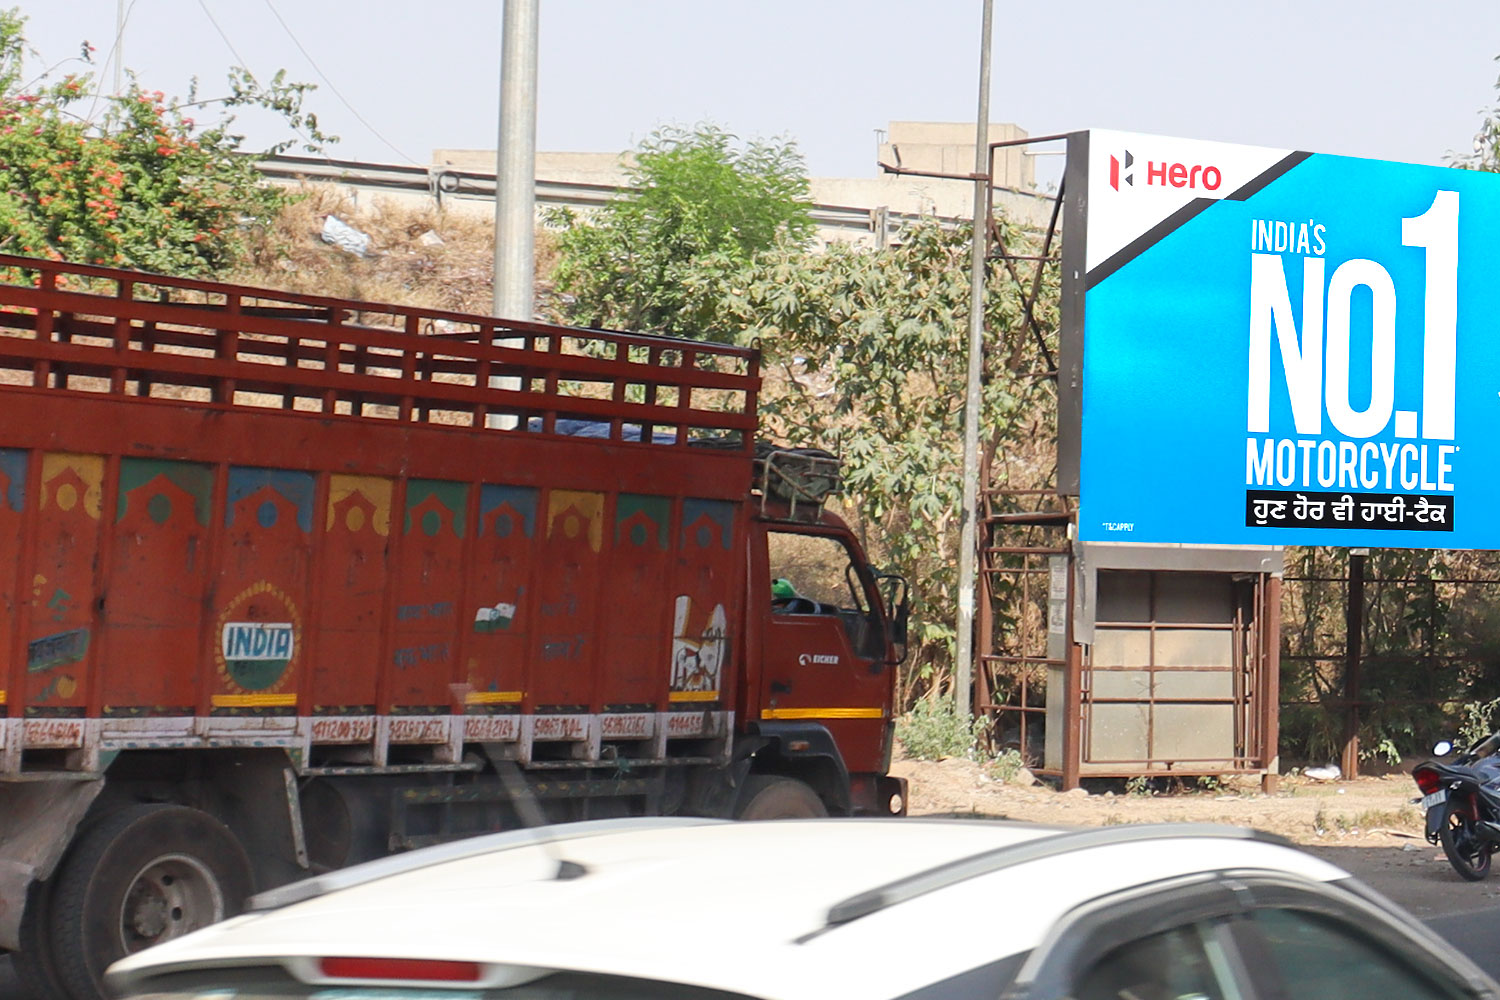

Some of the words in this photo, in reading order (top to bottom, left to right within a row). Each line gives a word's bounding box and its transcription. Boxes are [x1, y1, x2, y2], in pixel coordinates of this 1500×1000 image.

[1147, 160, 1222, 191] Hero
[1252, 218, 1326, 256] INDIA'S
[1247, 189, 1460, 441] NO.1
[1253, 499, 1288, 525] ਹੁਣ
[1293, 493, 1326, 520] ਹੋਰ
[1331, 494, 1355, 521] ਵੀ
[1360, 496, 1447, 524] ਹਾਈ-ਟੈਕ
[227, 626, 291, 657] INDIA
